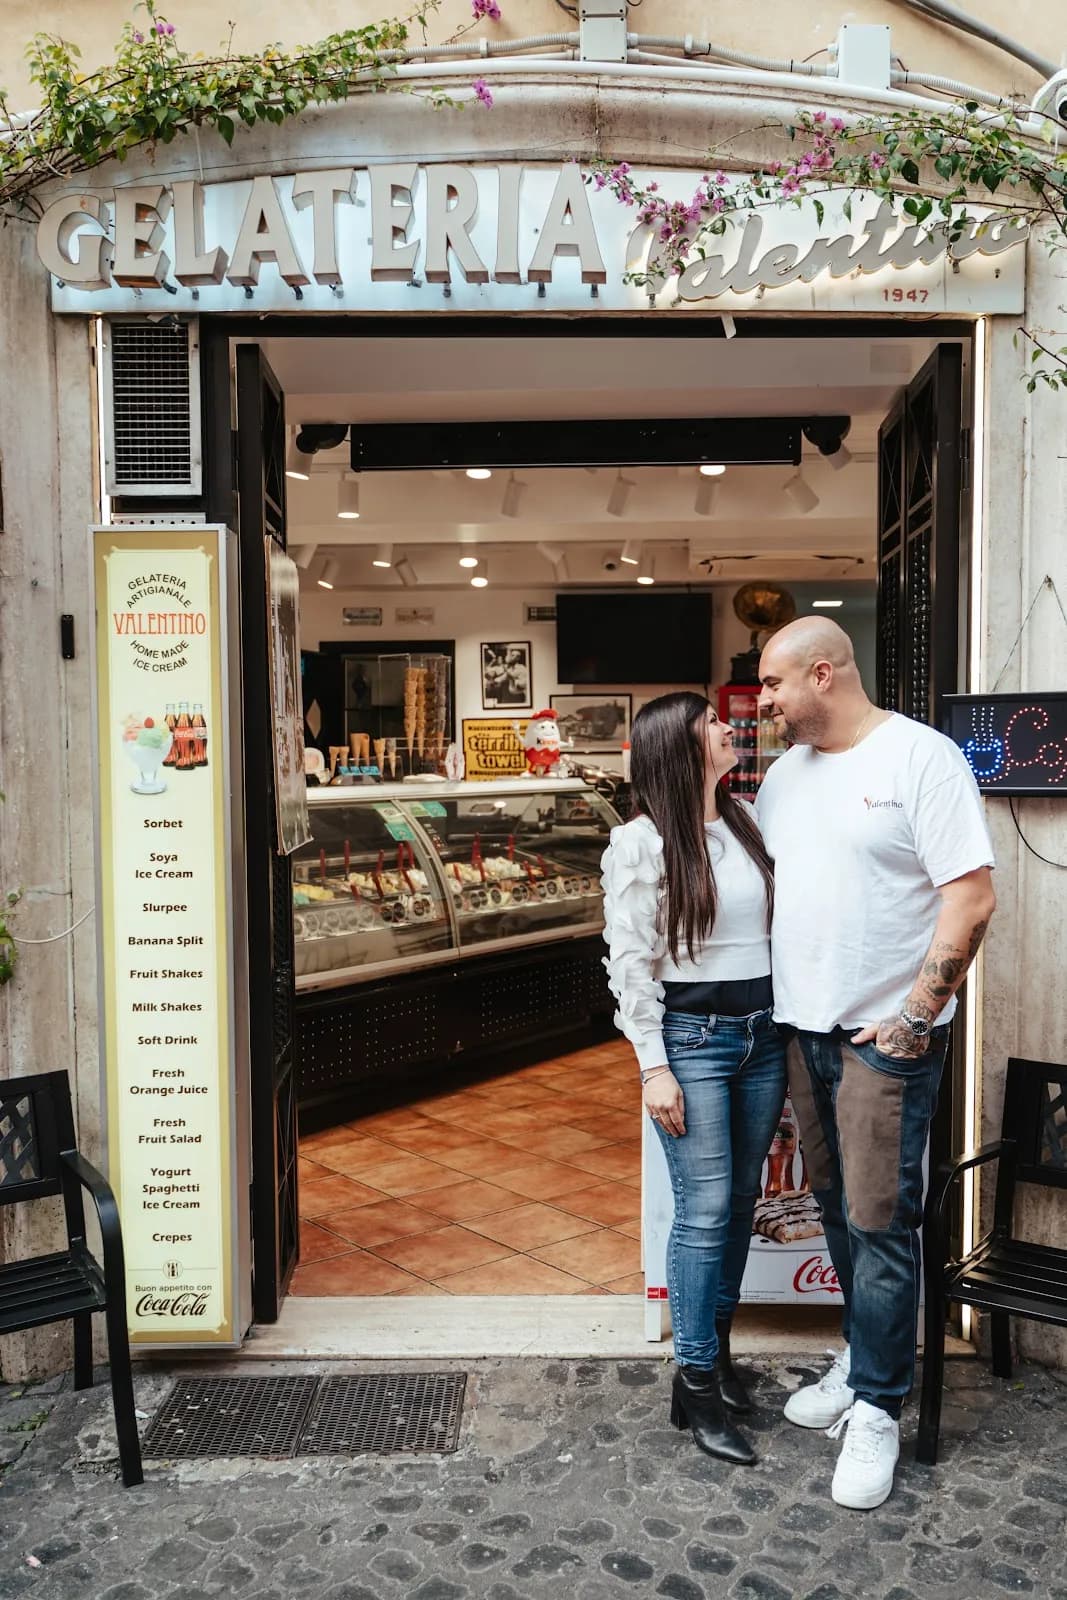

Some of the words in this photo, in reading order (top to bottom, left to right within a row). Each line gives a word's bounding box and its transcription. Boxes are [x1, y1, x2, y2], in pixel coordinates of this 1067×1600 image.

[36, 163, 606, 290] GELATERIA
[883, 288, 929, 303] 1947
[127, 573, 187, 591] GELATERIA
[126, 585, 192, 609] ARTIGIANALE
[113, 612, 207, 635] VALENTINO
[129, 639, 160, 659] HOME
[161, 639, 190, 659] MADE
[132, 658, 151, 671] ICE
[151, 656, 189, 673] CREAM
[1004, 706, 1067, 783] Co
[477, 751, 527, 768] towel
[864, 797, 903, 811] Valentino
[143, 818, 183, 829] Sorbet
[149, 852, 178, 865] Soya
[135, 869, 152, 879] Ice
[155, 869, 193, 879] Cream
[142, 902, 188, 914] Slurpee
[128, 935, 174, 946] Banana
[176, 935, 204, 948] Split
[129, 968, 158, 979] Fruit
[161, 968, 203, 979] Shakes
[132, 1002, 158, 1012] Milk
[160, 1002, 203, 1012] Shakes
[137, 1034, 162, 1045] Soft
[164, 1034, 198, 1045] Drink
[152, 1068, 185, 1078] Fresh
[129, 1085, 175, 1097] Orange
[177, 1084, 209, 1095] Juice
[153, 1117, 186, 1127] Fresh
[138, 1134, 167, 1144] Fruit
[169, 1134, 202, 1144] Salad
[150, 1166, 191, 1179] Yogurt
[142, 1183, 200, 1196] Spaghetti
[142, 1201, 160, 1210] Ice
[162, 1200, 201, 1210] Cream
[152, 1232, 193, 1245] Crepes
[159, 1284, 195, 1293] appetito
[136, 1292, 209, 1317] Coca-Cola
